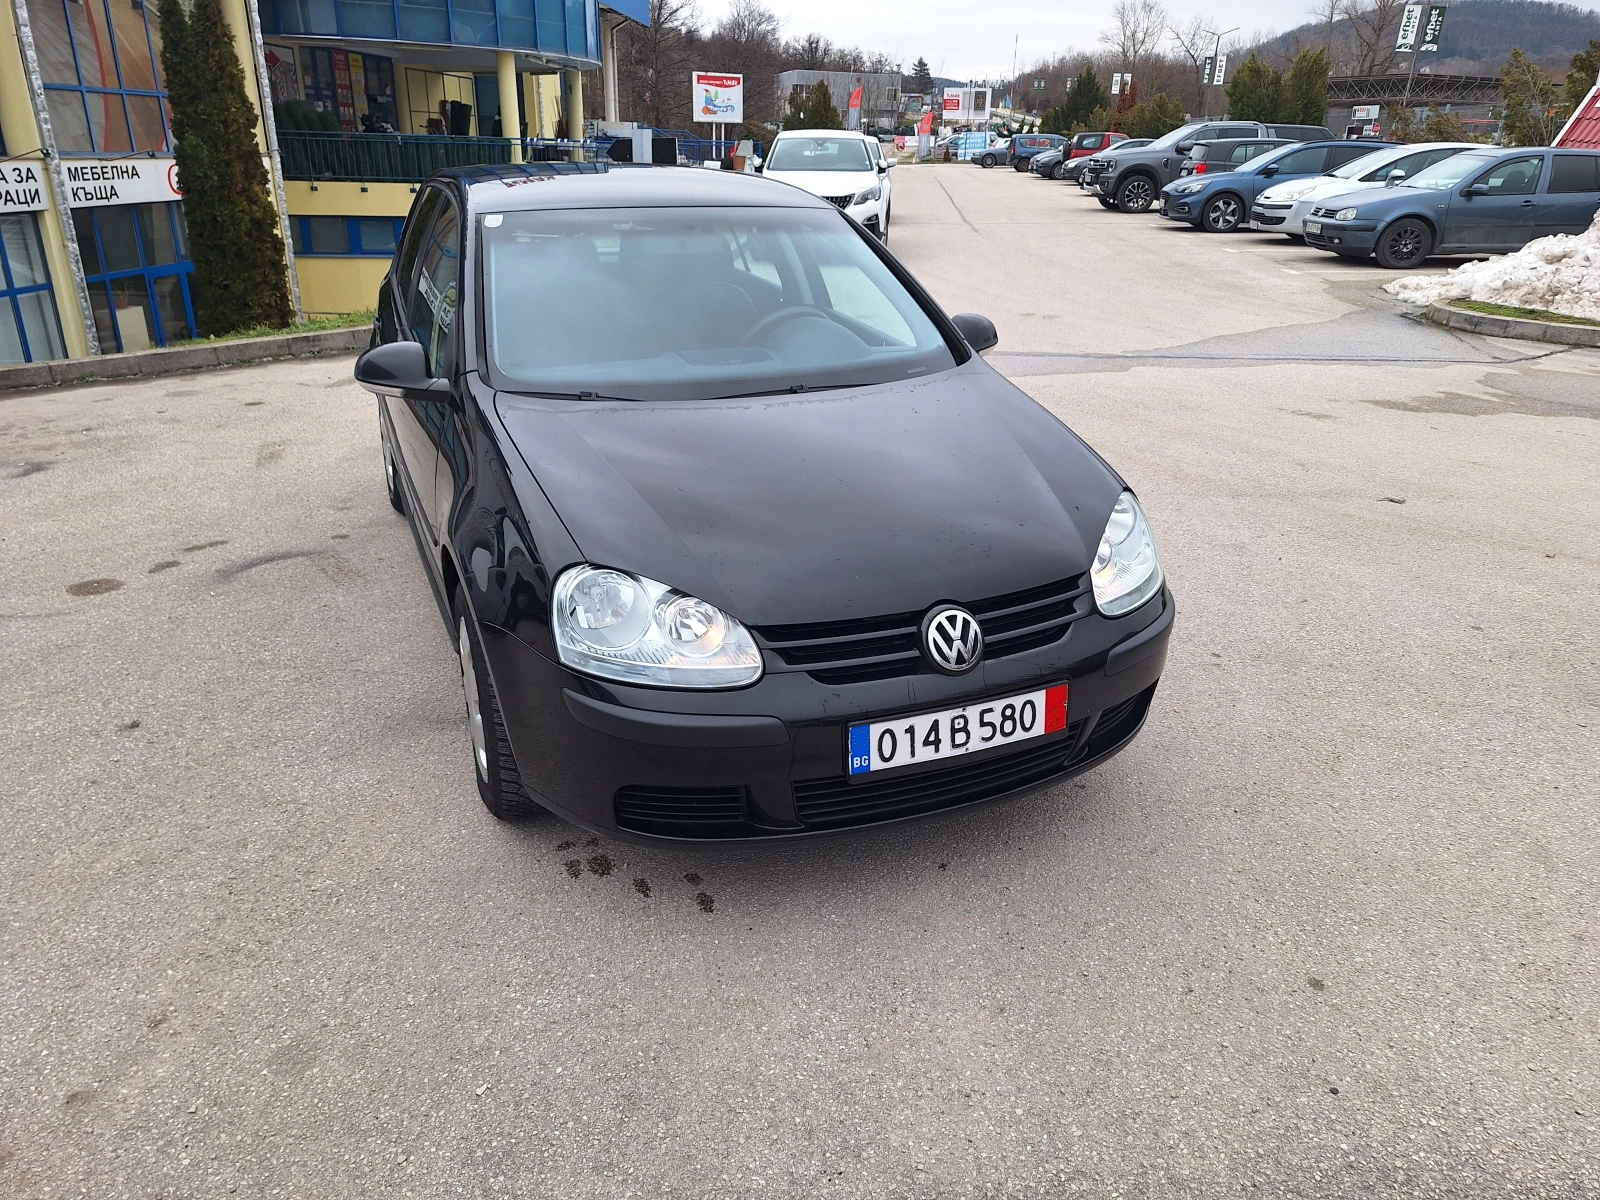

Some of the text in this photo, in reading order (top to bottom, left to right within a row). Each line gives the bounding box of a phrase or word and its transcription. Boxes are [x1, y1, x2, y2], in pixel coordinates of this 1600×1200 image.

[1402, 8, 1414, 40] efbet
[1425, 8, 1440, 42] efbet
[12, 167, 38, 184] ЗА
[67, 164, 141, 182] МЕБЕЛНА
[71, 184, 120, 202] КЪЩА
[853, 756, 869, 768] BG
